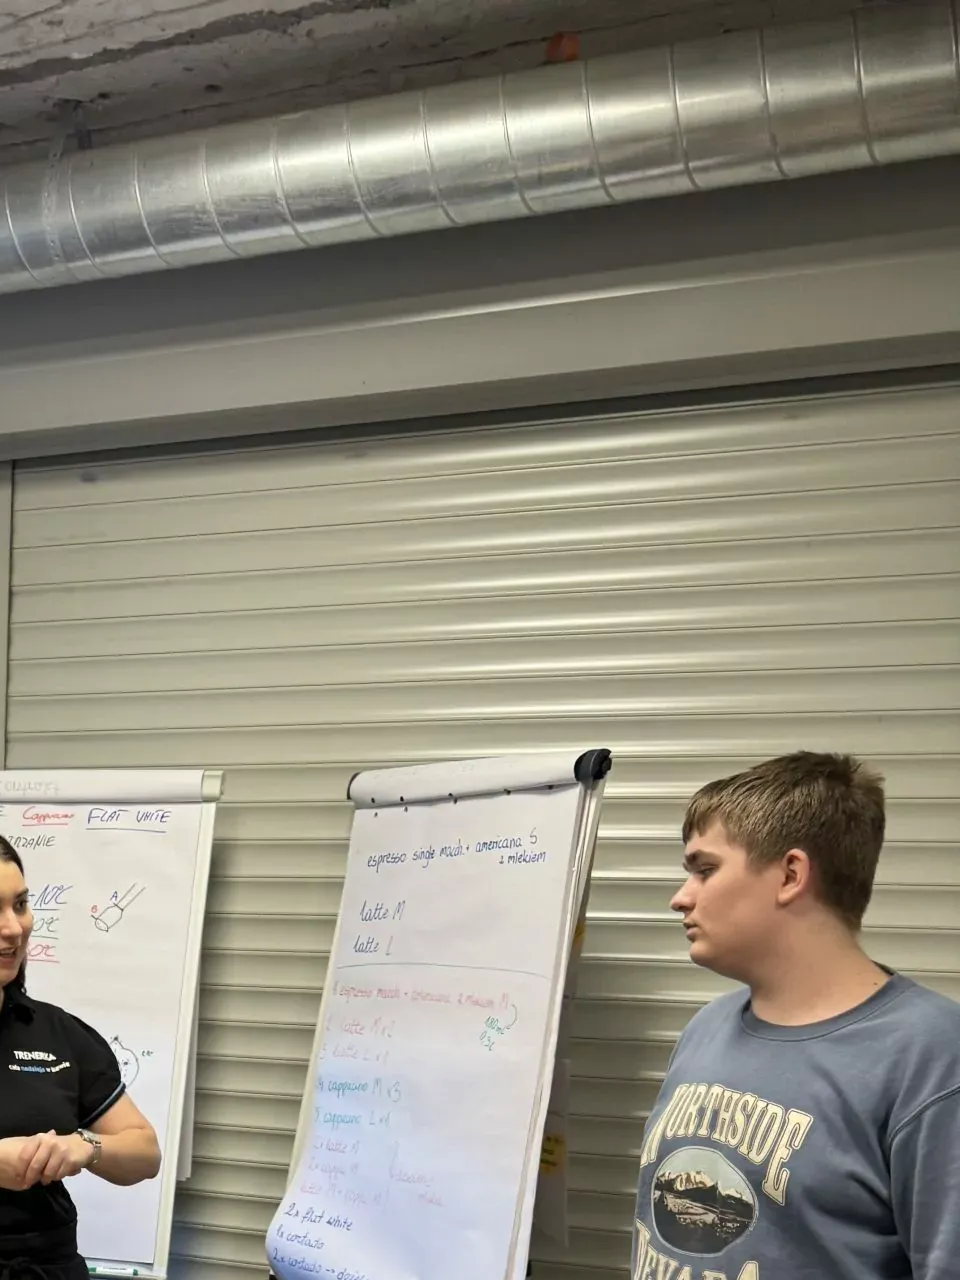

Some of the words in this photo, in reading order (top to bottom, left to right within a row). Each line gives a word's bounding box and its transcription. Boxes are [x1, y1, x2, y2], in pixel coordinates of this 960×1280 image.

[88, 808, 128, 824] FLAT
[367, 852, 407, 873] espresso
[412, 844, 435, 868] single
[476, 835, 523, 853] americana
[507, 850, 546, 864] mlekiem
[110, 891, 118, 901] A
[360, 900, 389, 922] latte
[392, 900, 406, 920] M
[353, 935, 380, 954] latte
[326, 1214, 353, 1231] white
